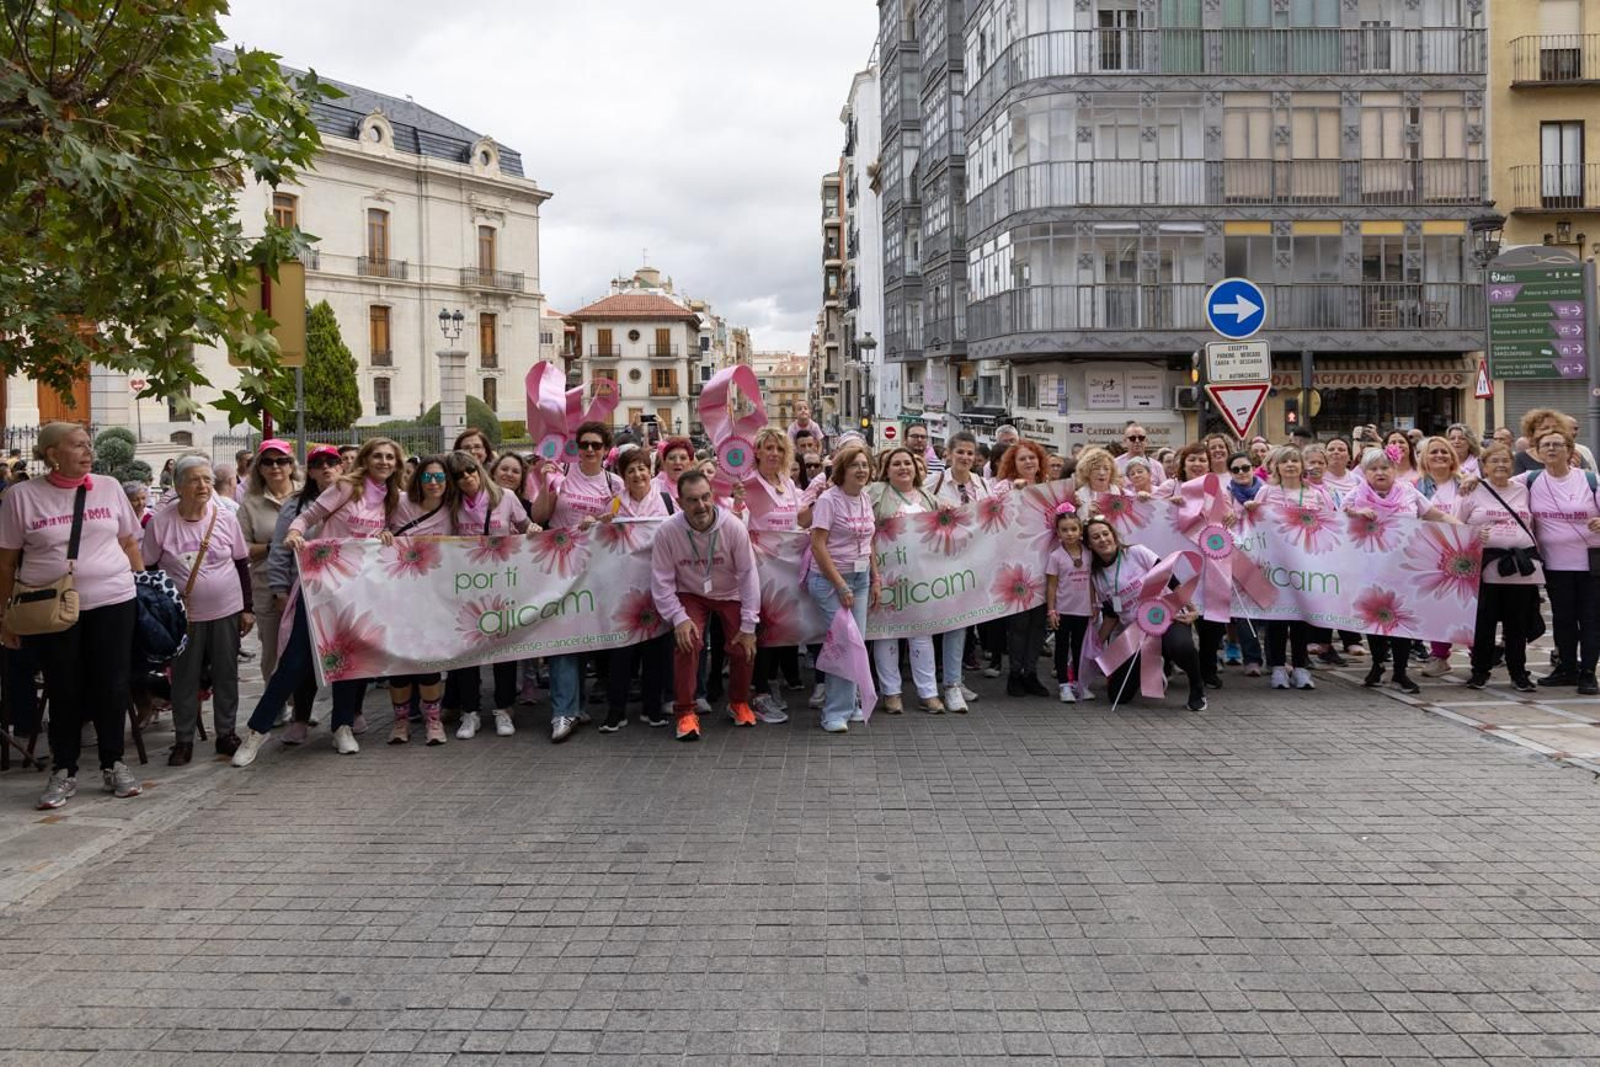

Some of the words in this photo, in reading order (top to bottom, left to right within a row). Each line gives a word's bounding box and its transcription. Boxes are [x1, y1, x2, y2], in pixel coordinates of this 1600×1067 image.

[1311, 373, 1383, 385] AGITARIO
[1389, 373, 1463, 385] REGALOS
[57, 514, 73, 525] VIST
[87, 507, 112, 520] ROSA
[455, 571, 498, 594] por
[880, 570, 975, 611] ajicam
[478, 589, 595, 637] ajicam
